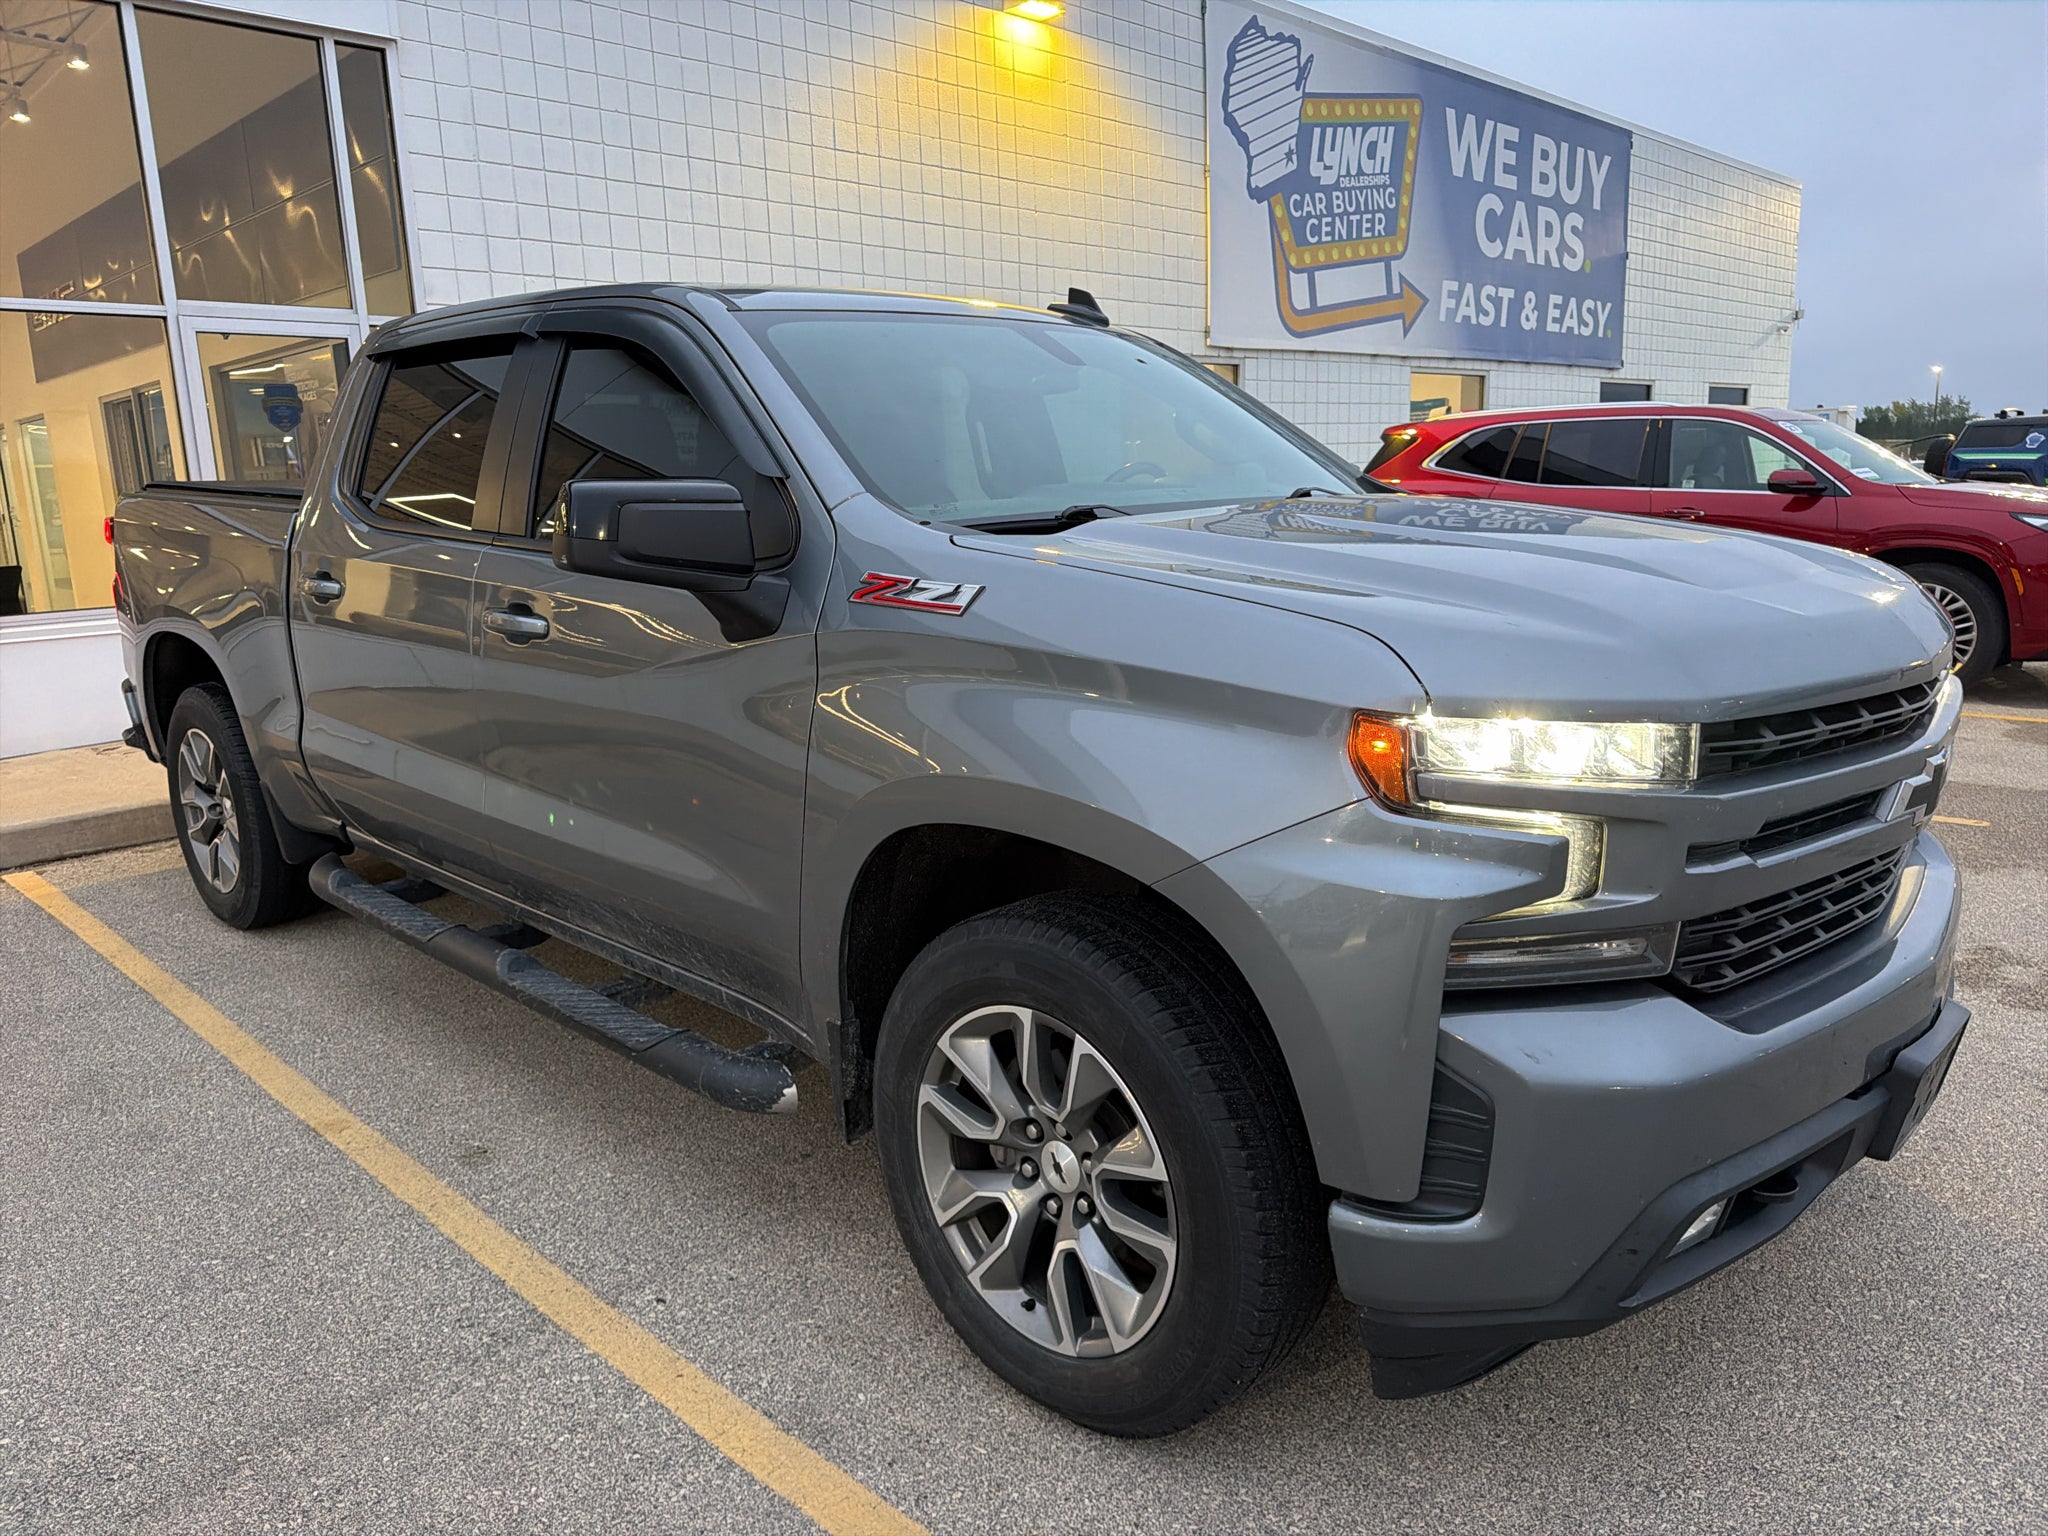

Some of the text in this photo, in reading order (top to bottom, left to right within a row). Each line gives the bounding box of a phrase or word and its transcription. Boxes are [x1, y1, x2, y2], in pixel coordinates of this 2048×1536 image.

[1310, 126, 1395, 185] LYNCH
[1445, 107, 1612, 211] WE BUY
[1289, 187, 1396, 218] CAR BUYING
[1339, 174, 1390, 188] DEALERSHIPS
[1305, 213, 1386, 243] CENTER
[1439, 279, 1515, 328] FAST
[1520, 290, 1539, 331] &
[848, 570, 986, 617] Z71
